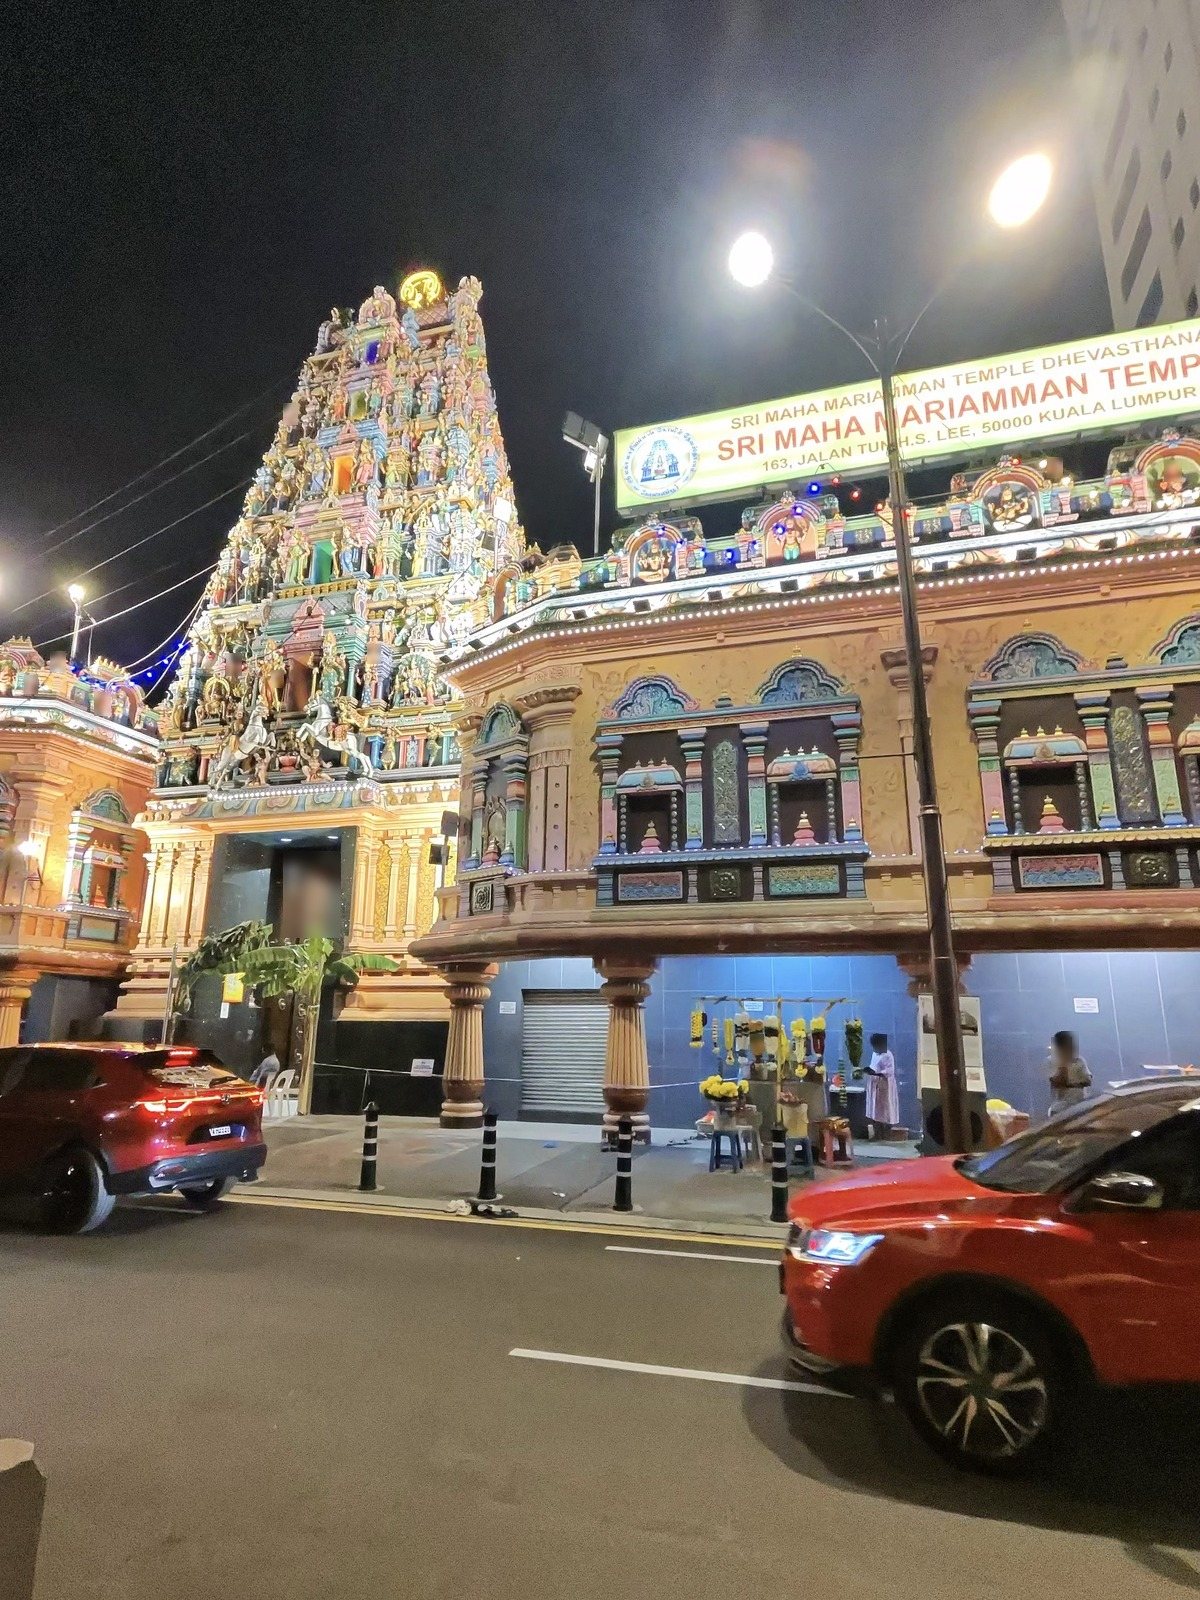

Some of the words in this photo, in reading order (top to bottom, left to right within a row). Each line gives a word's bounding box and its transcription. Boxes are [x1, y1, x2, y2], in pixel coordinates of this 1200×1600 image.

[718, 433, 764, 461] SRI
[775, 415, 865, 451] MAHA
[874, 373, 1088, 433] MARIAMMAN
[731, 413, 760, 429] SRI
[766, 403, 819, 423] MAHA
[952, 361, 1035, 386] TEMPLE
[763, 458, 793, 471] 163,
[798, 446, 852, 466] JALAN
[898, 433, 930, 448] H.S.
[937, 425, 976, 441] LEE,
[982, 414, 1033, 433] 50000
[1039, 401, 1106, 423] KUALA
[1111, 386, 1197, 410] LUMPUR
